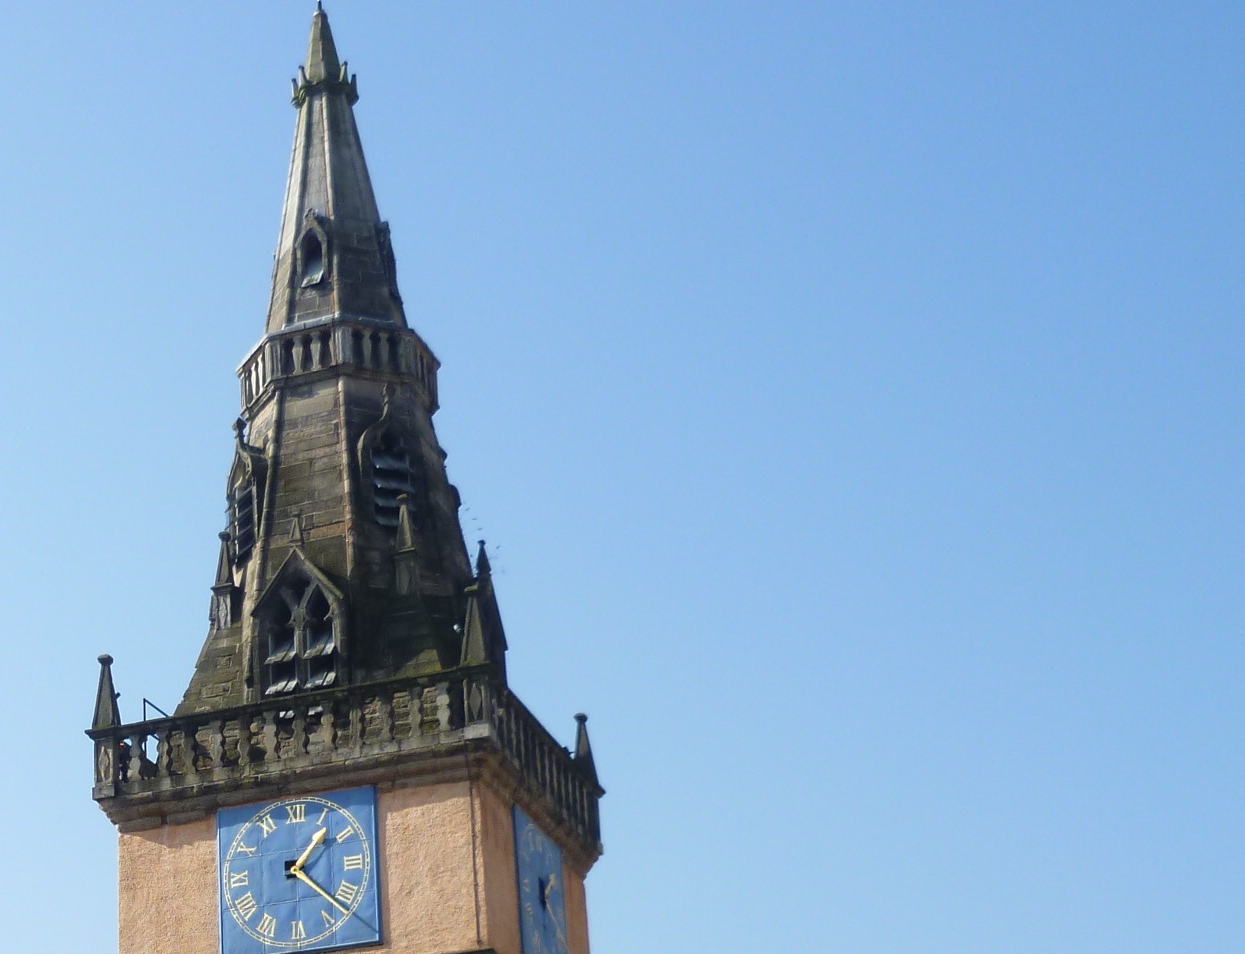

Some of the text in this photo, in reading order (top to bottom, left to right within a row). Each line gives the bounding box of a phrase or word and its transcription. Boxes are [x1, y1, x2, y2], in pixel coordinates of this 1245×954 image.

[286, 805, 305, 824] XII
[317, 808, 329, 825] I
[257, 814, 277, 838] XI
[336, 826, 355, 843] II
[237, 842, 257, 857] X
[344, 854, 363, 871] III
[235, 891, 258, 921] VIII
[256, 912, 276, 937] VII
[321, 910, 335, 927] V
[291, 920, 306, 939] VI
